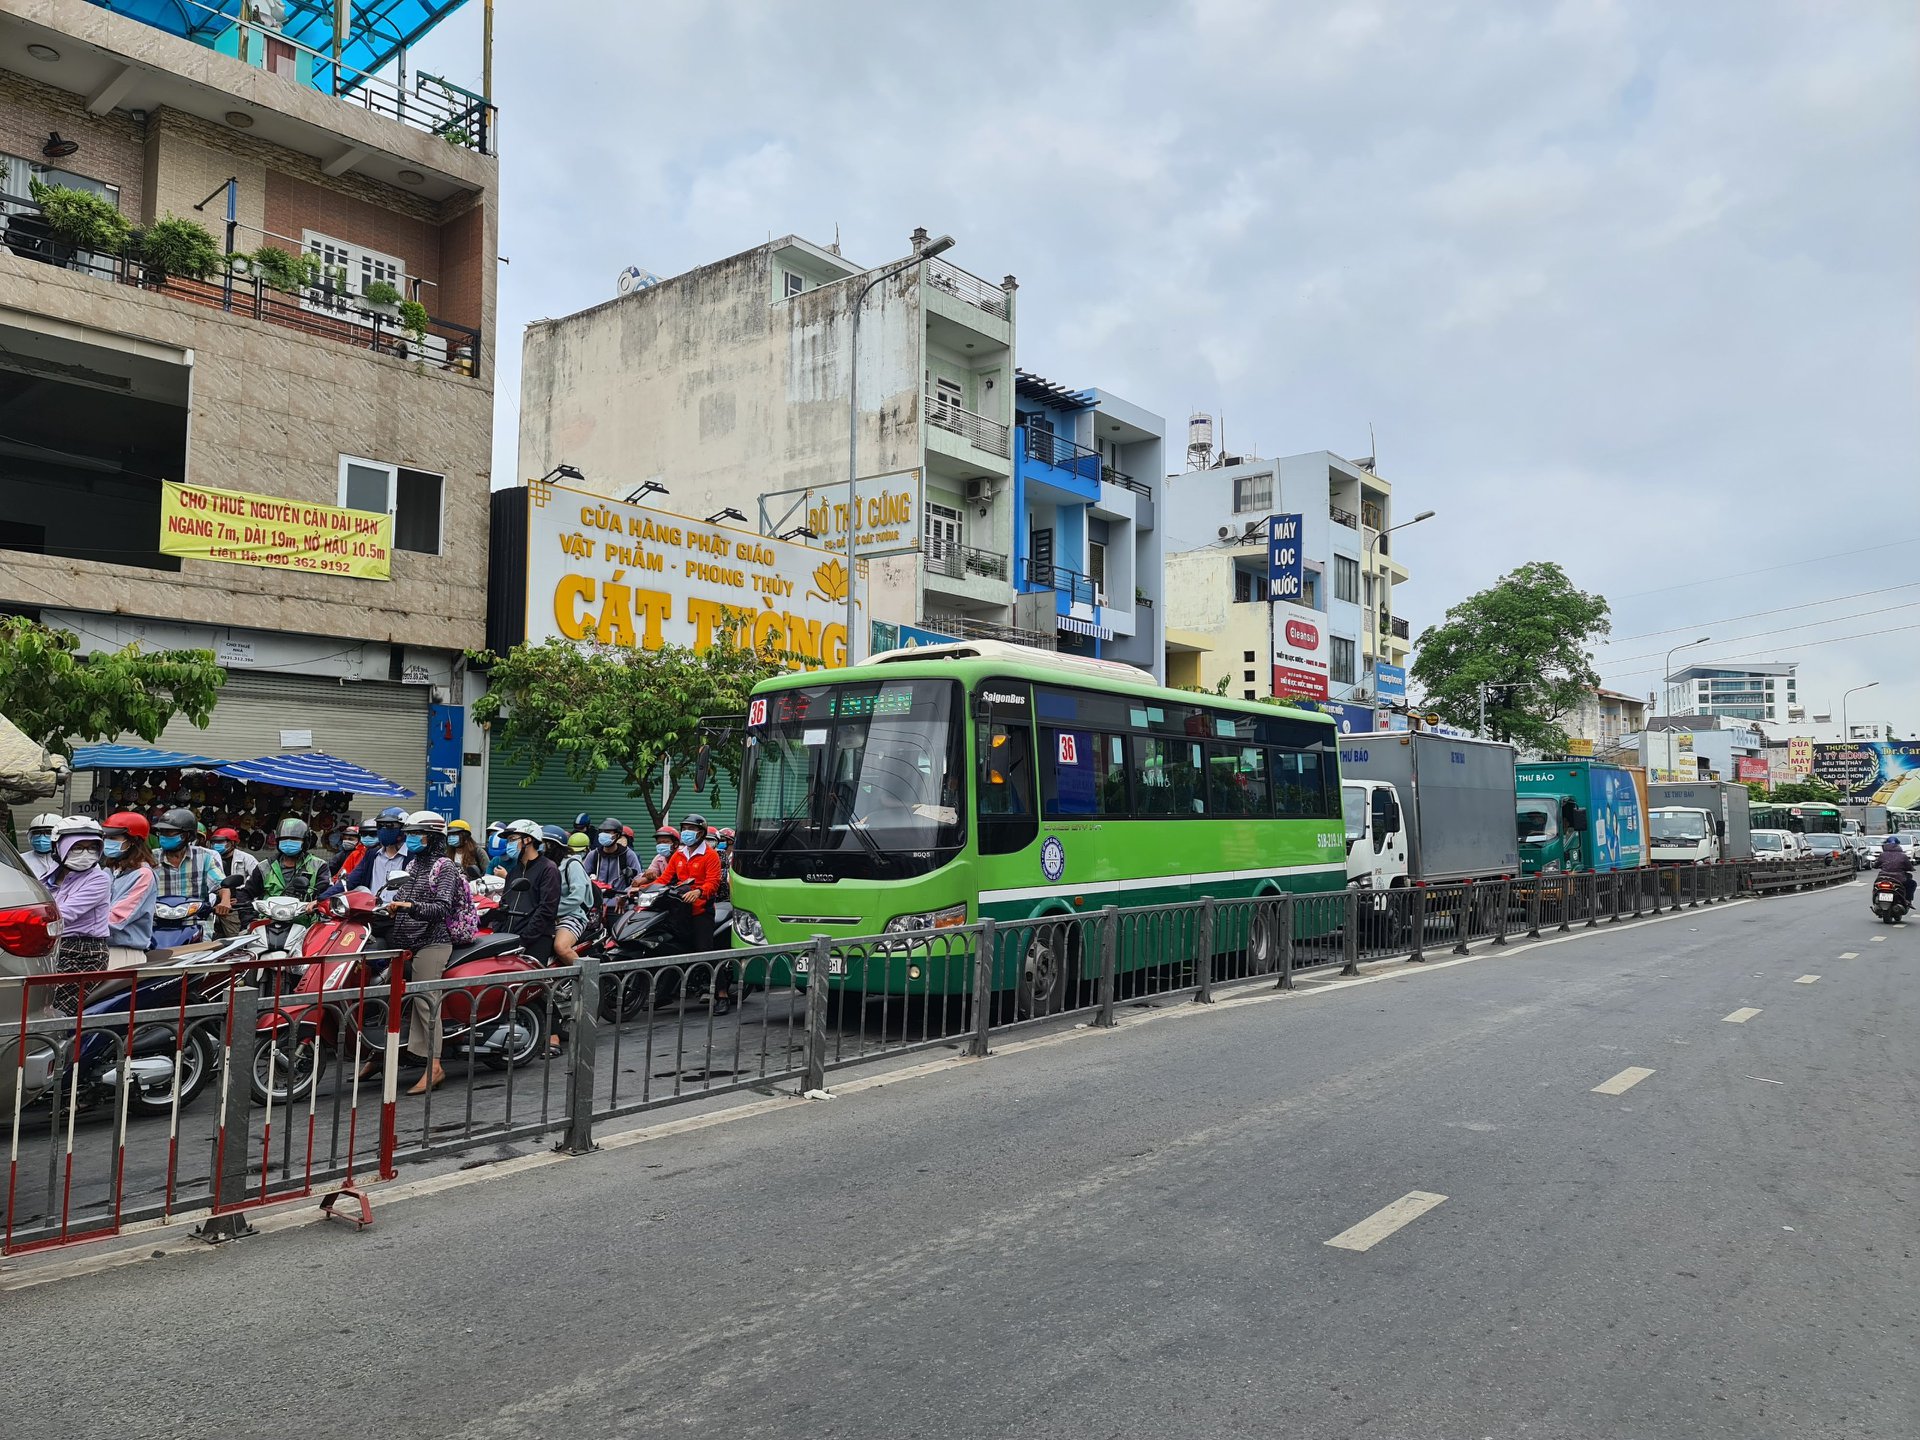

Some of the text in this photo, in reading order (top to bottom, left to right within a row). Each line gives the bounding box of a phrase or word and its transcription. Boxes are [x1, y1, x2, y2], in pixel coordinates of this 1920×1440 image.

[179, 490, 378, 538] CHO THUÊ NGUYÊN CĂN DÀI HẠN
[809, 496, 829, 536] ĐỒ
[868, 488, 911, 528] CÚNG
[168, 515, 385, 560] NGANG 7m, DÀI 19m, NỞ HẬU 10.5m
[581, 503, 775, 567] CỬA HÀNG PHẬT GIÁO
[1274, 517, 1296, 540] MÁY
[209, 545, 350, 573] Liên Hệ: 090 362 9192
[559, 532, 596, 560] VẬT
[605, 540, 663, 573] PHẨM
[685, 560, 744, 588] PHONG
[752, 573, 794, 597] THỦY
[1275, 548, 1295, 569] LỌC
[1271, 572, 1298, 596] NƯỚC
[554, 570, 848, 671] CÁT TƯỜNG
[983, 691, 1025, 704] SaigonBus
[751, 700, 764, 725] 36
[1061, 736, 1074, 761] 36
[1354, 746, 1369, 762] BÁO
[1518, 772, 1555, 782] THƯ BÁO
[806, 874, 834, 882] SAMCO
